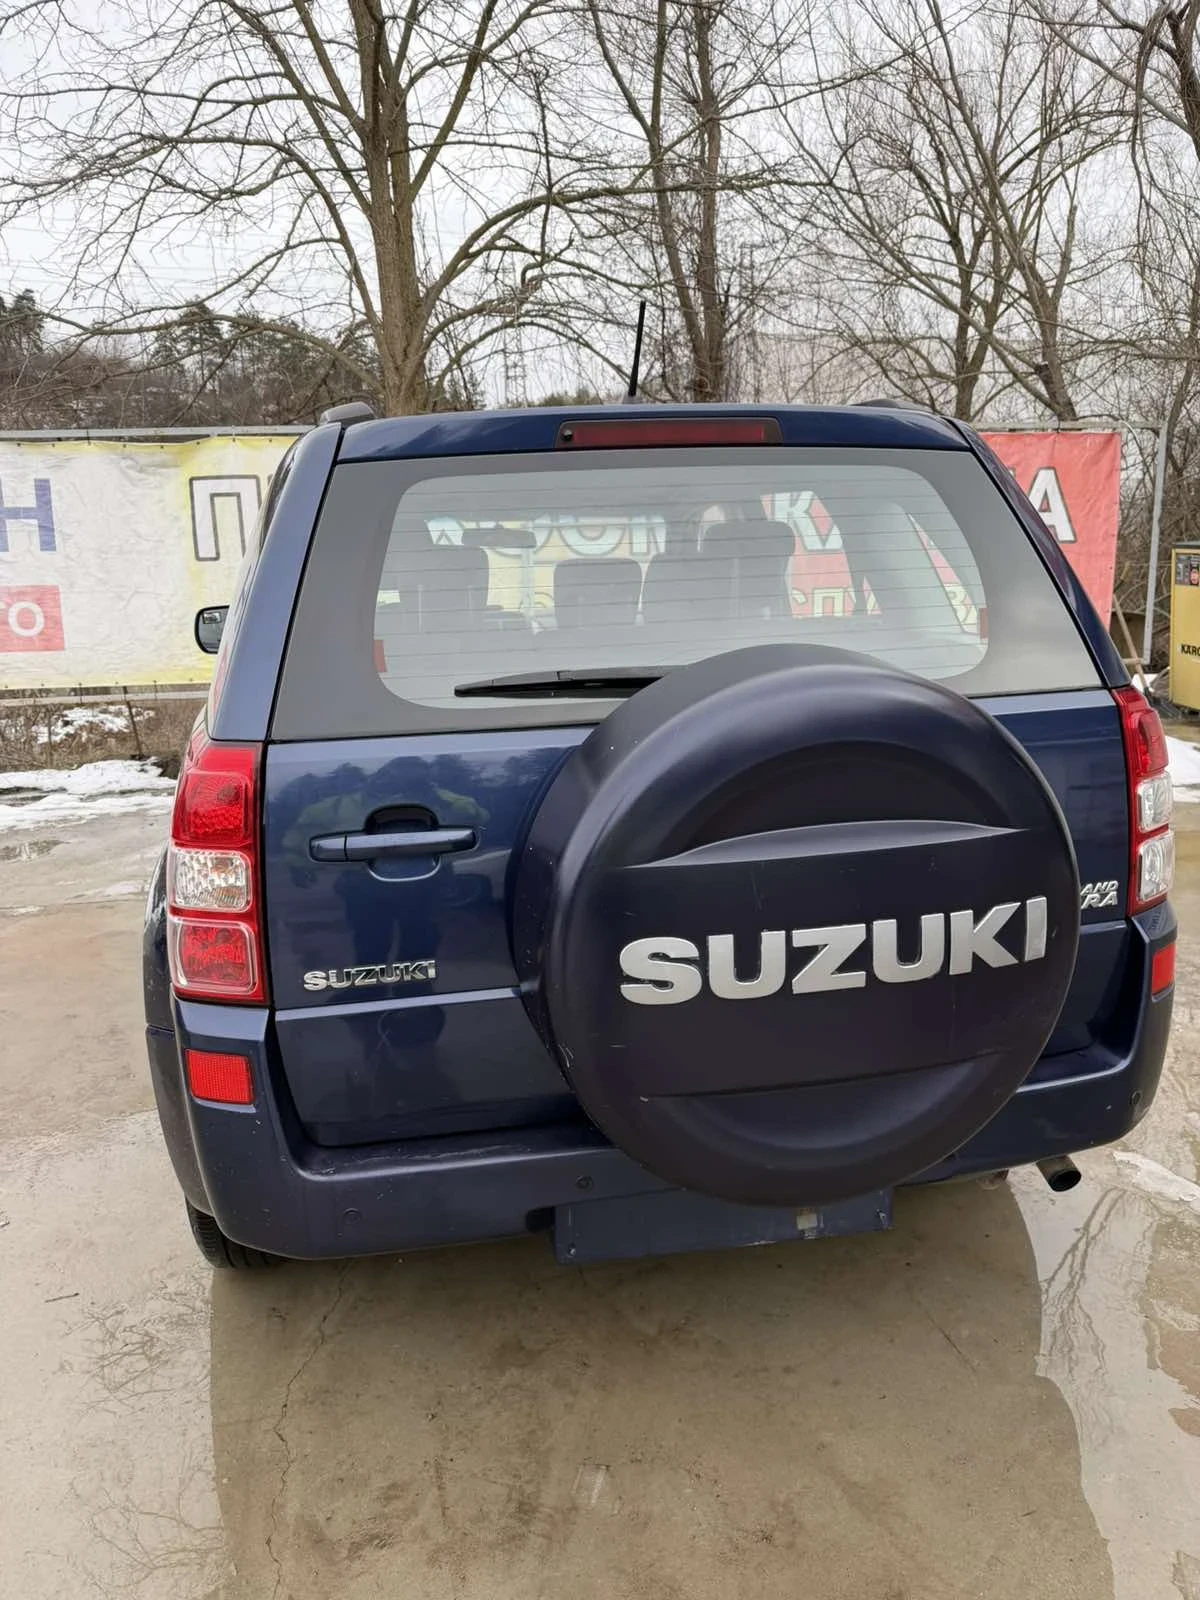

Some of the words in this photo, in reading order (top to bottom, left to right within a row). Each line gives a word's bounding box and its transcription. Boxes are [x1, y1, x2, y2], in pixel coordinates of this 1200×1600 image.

[189, 474, 273, 561] П
[303, 959, 437, 991] SUZUKI
[619, 895, 1048, 1006] SUZUKI
